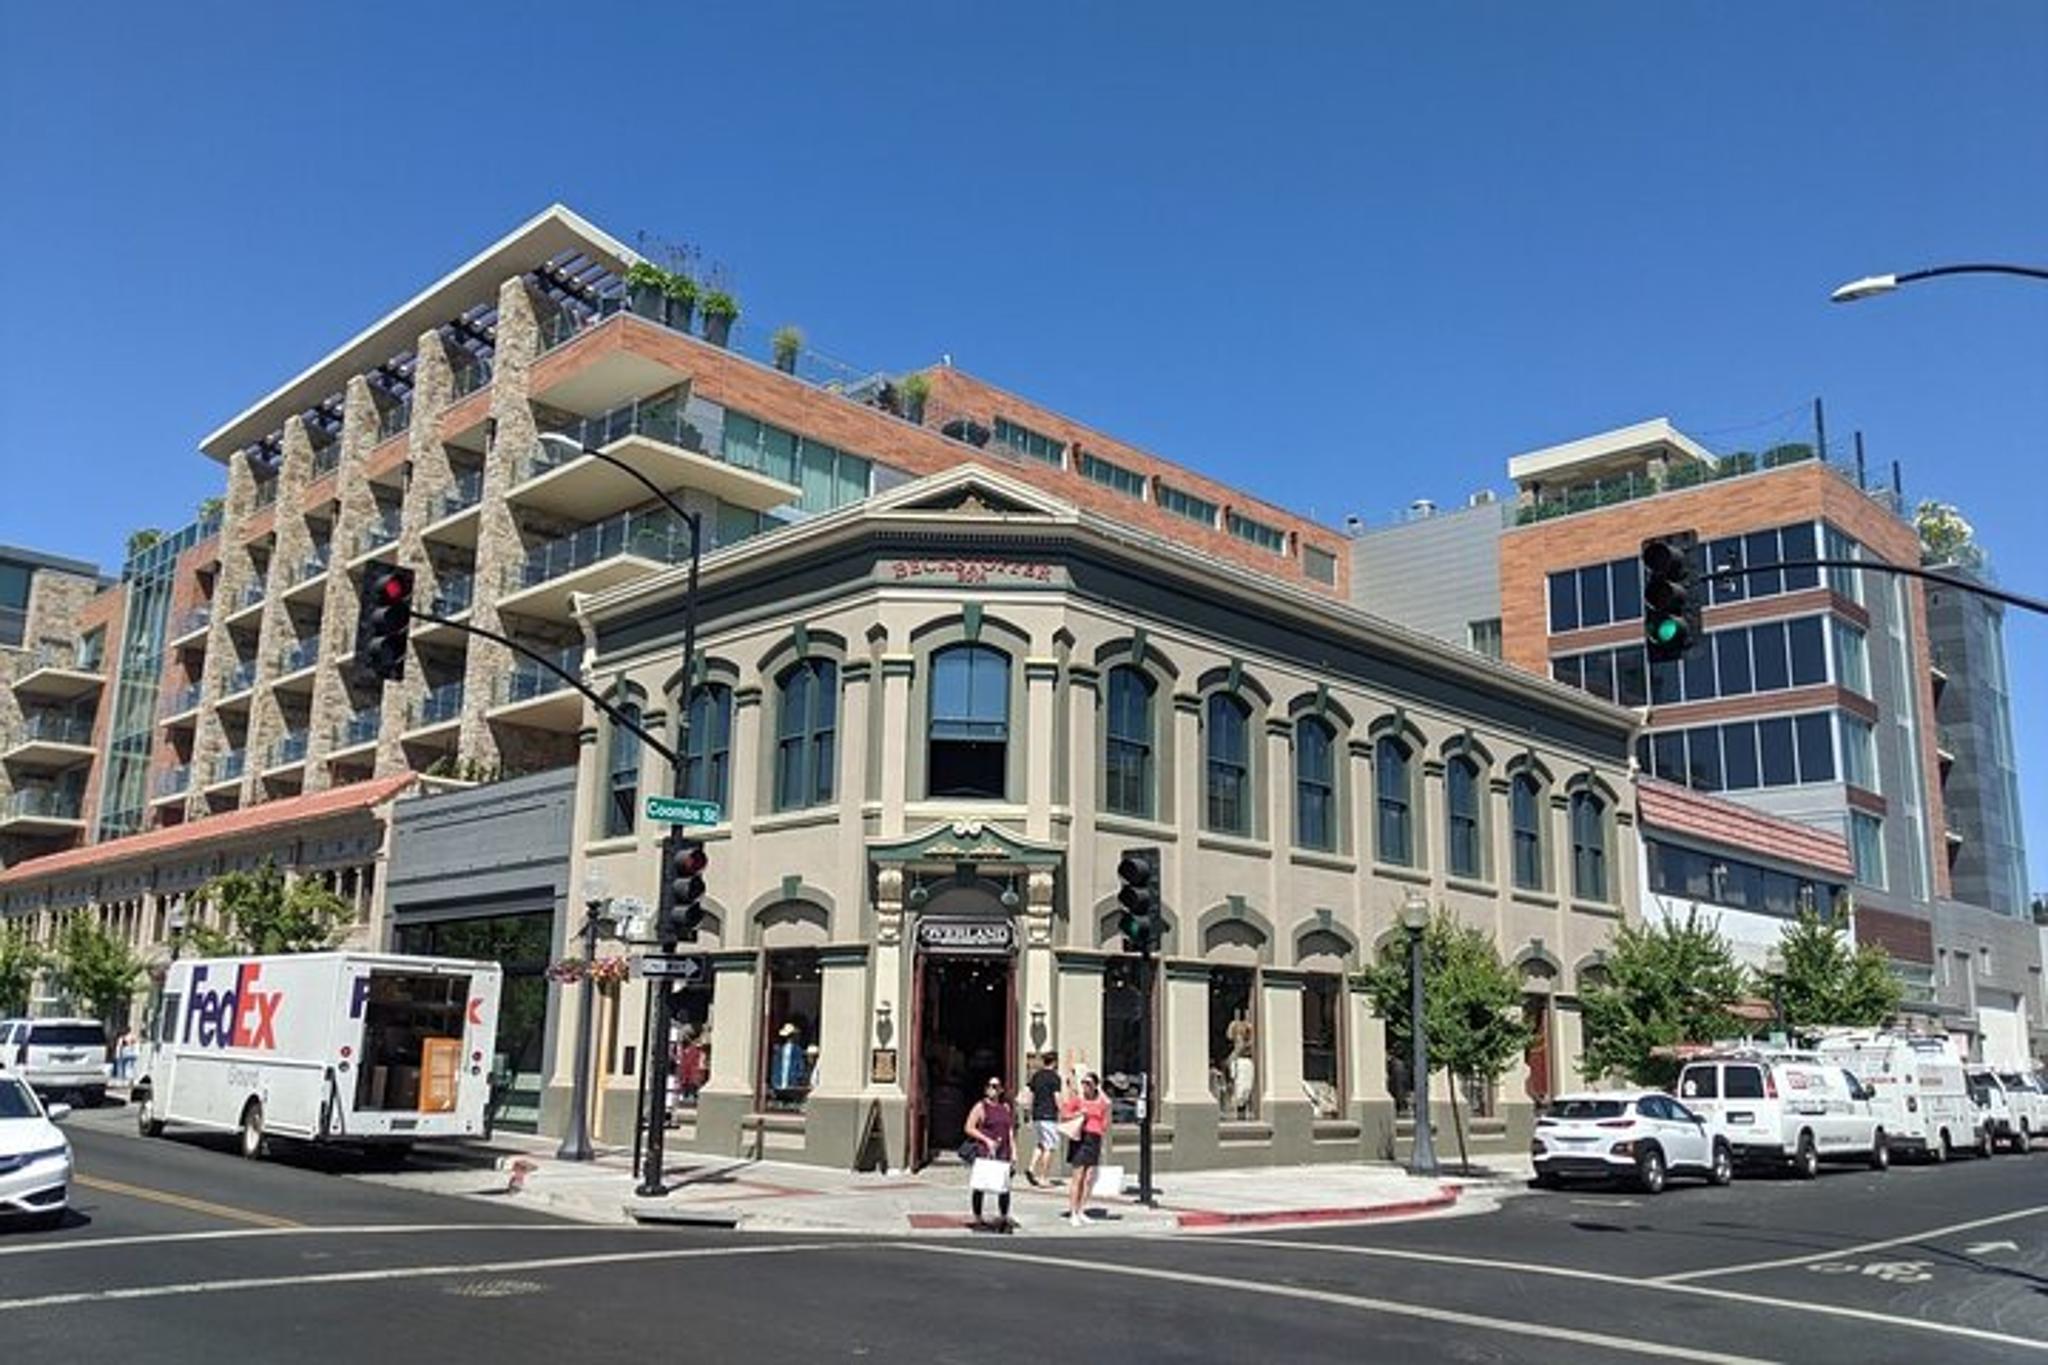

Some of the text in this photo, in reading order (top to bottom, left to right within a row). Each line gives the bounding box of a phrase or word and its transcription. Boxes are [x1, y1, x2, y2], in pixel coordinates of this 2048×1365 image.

[648, 801, 719, 823] Coombs St
[183, 963, 282, 1050] FedEx
